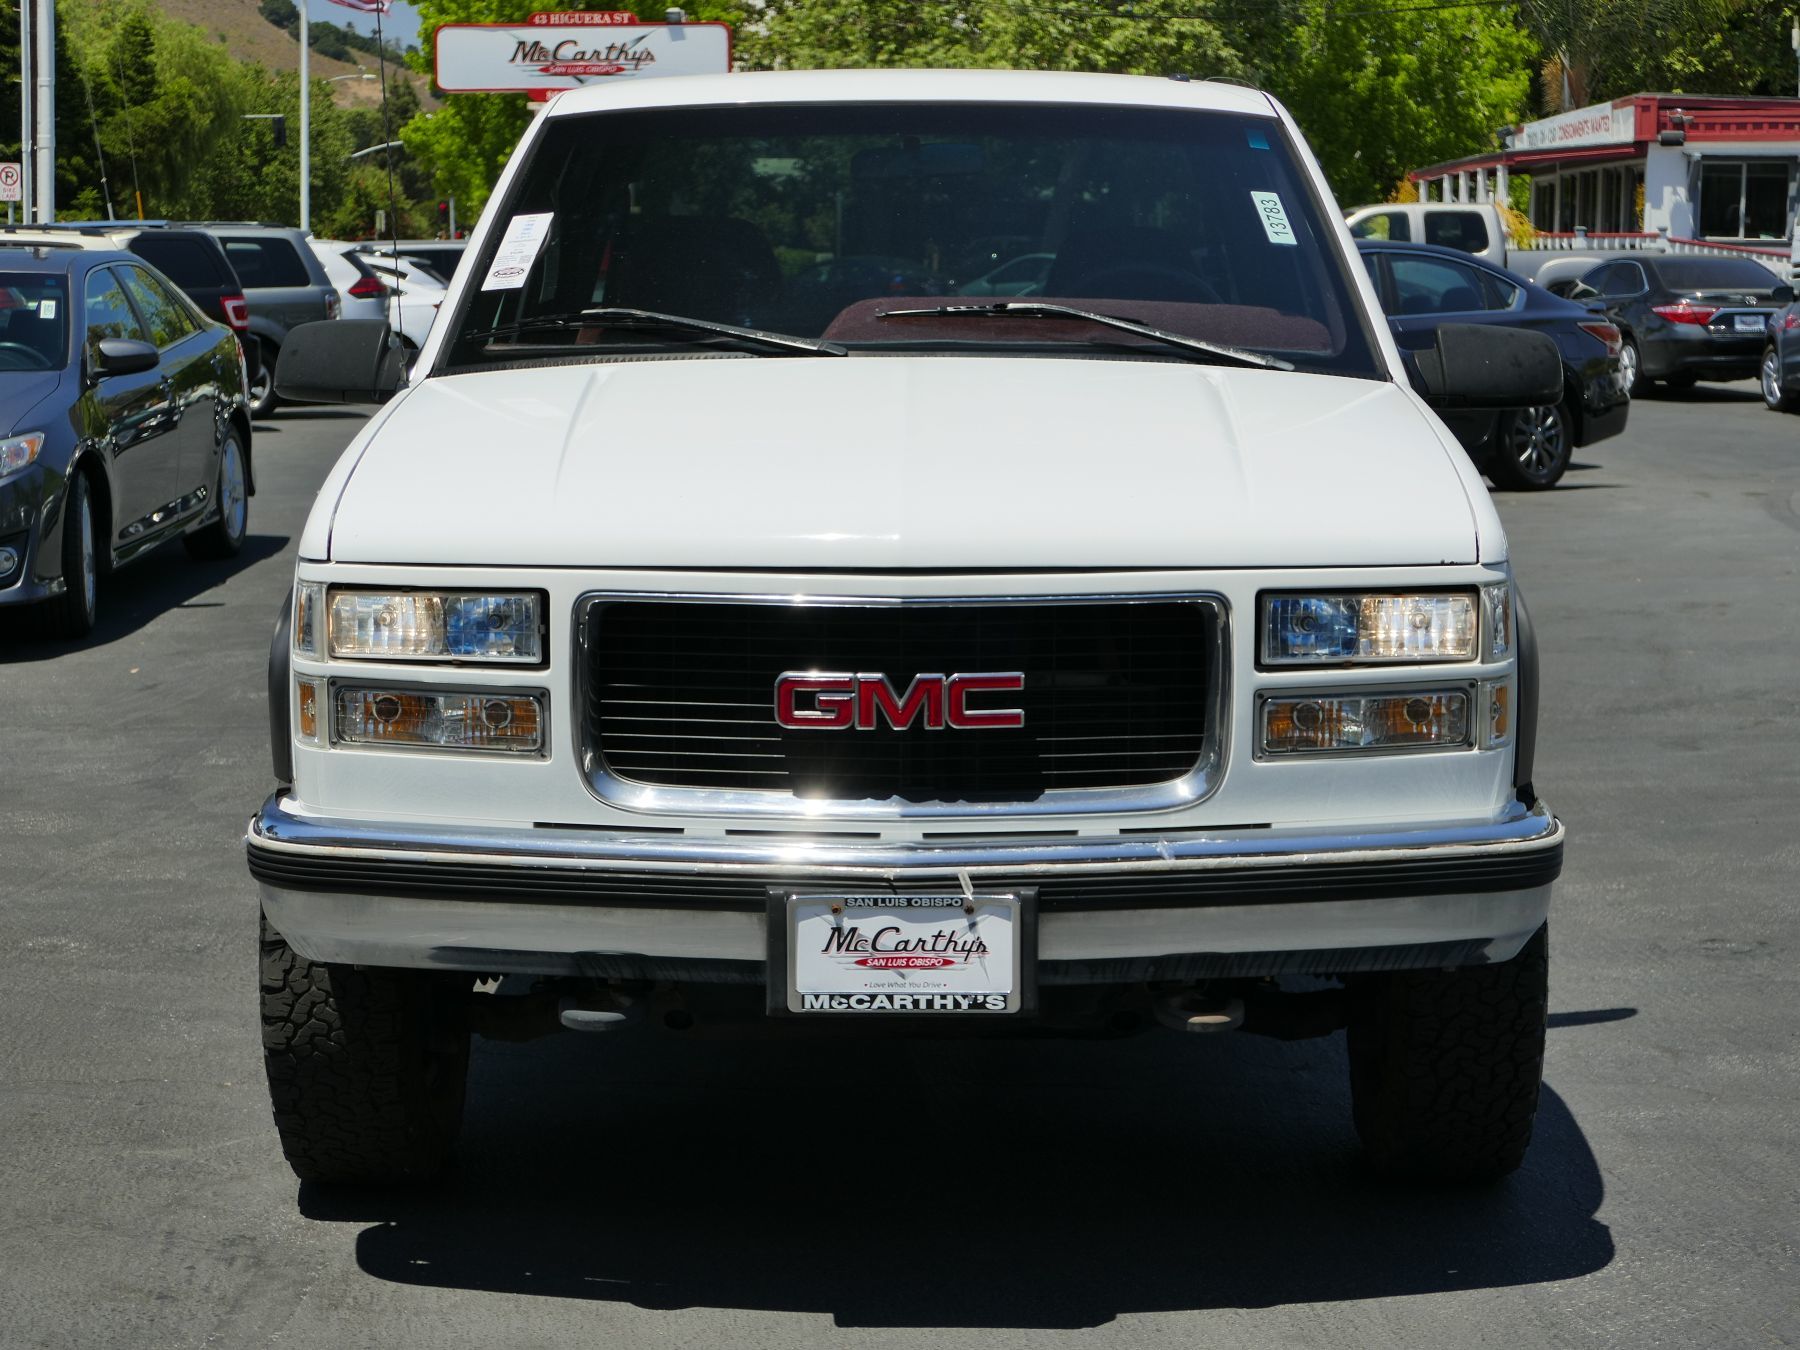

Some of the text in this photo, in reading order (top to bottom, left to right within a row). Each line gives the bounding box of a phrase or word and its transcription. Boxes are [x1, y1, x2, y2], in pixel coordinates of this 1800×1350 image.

[533, 12, 631, 24] 43 HIGUERA ST
[509, 39, 656, 69] McCarthy's
[549, 65, 618, 73] SAN LUIS OBISPO
[1260, 199, 1289, 236] 13783
[774, 671, 1025, 731] GMC
[847, 898, 962, 907] SAN LUIS OBISPO
[821, 926, 990, 963] McCarthy's
[866, 958, 944, 967] SAN LUIS OBISPO
